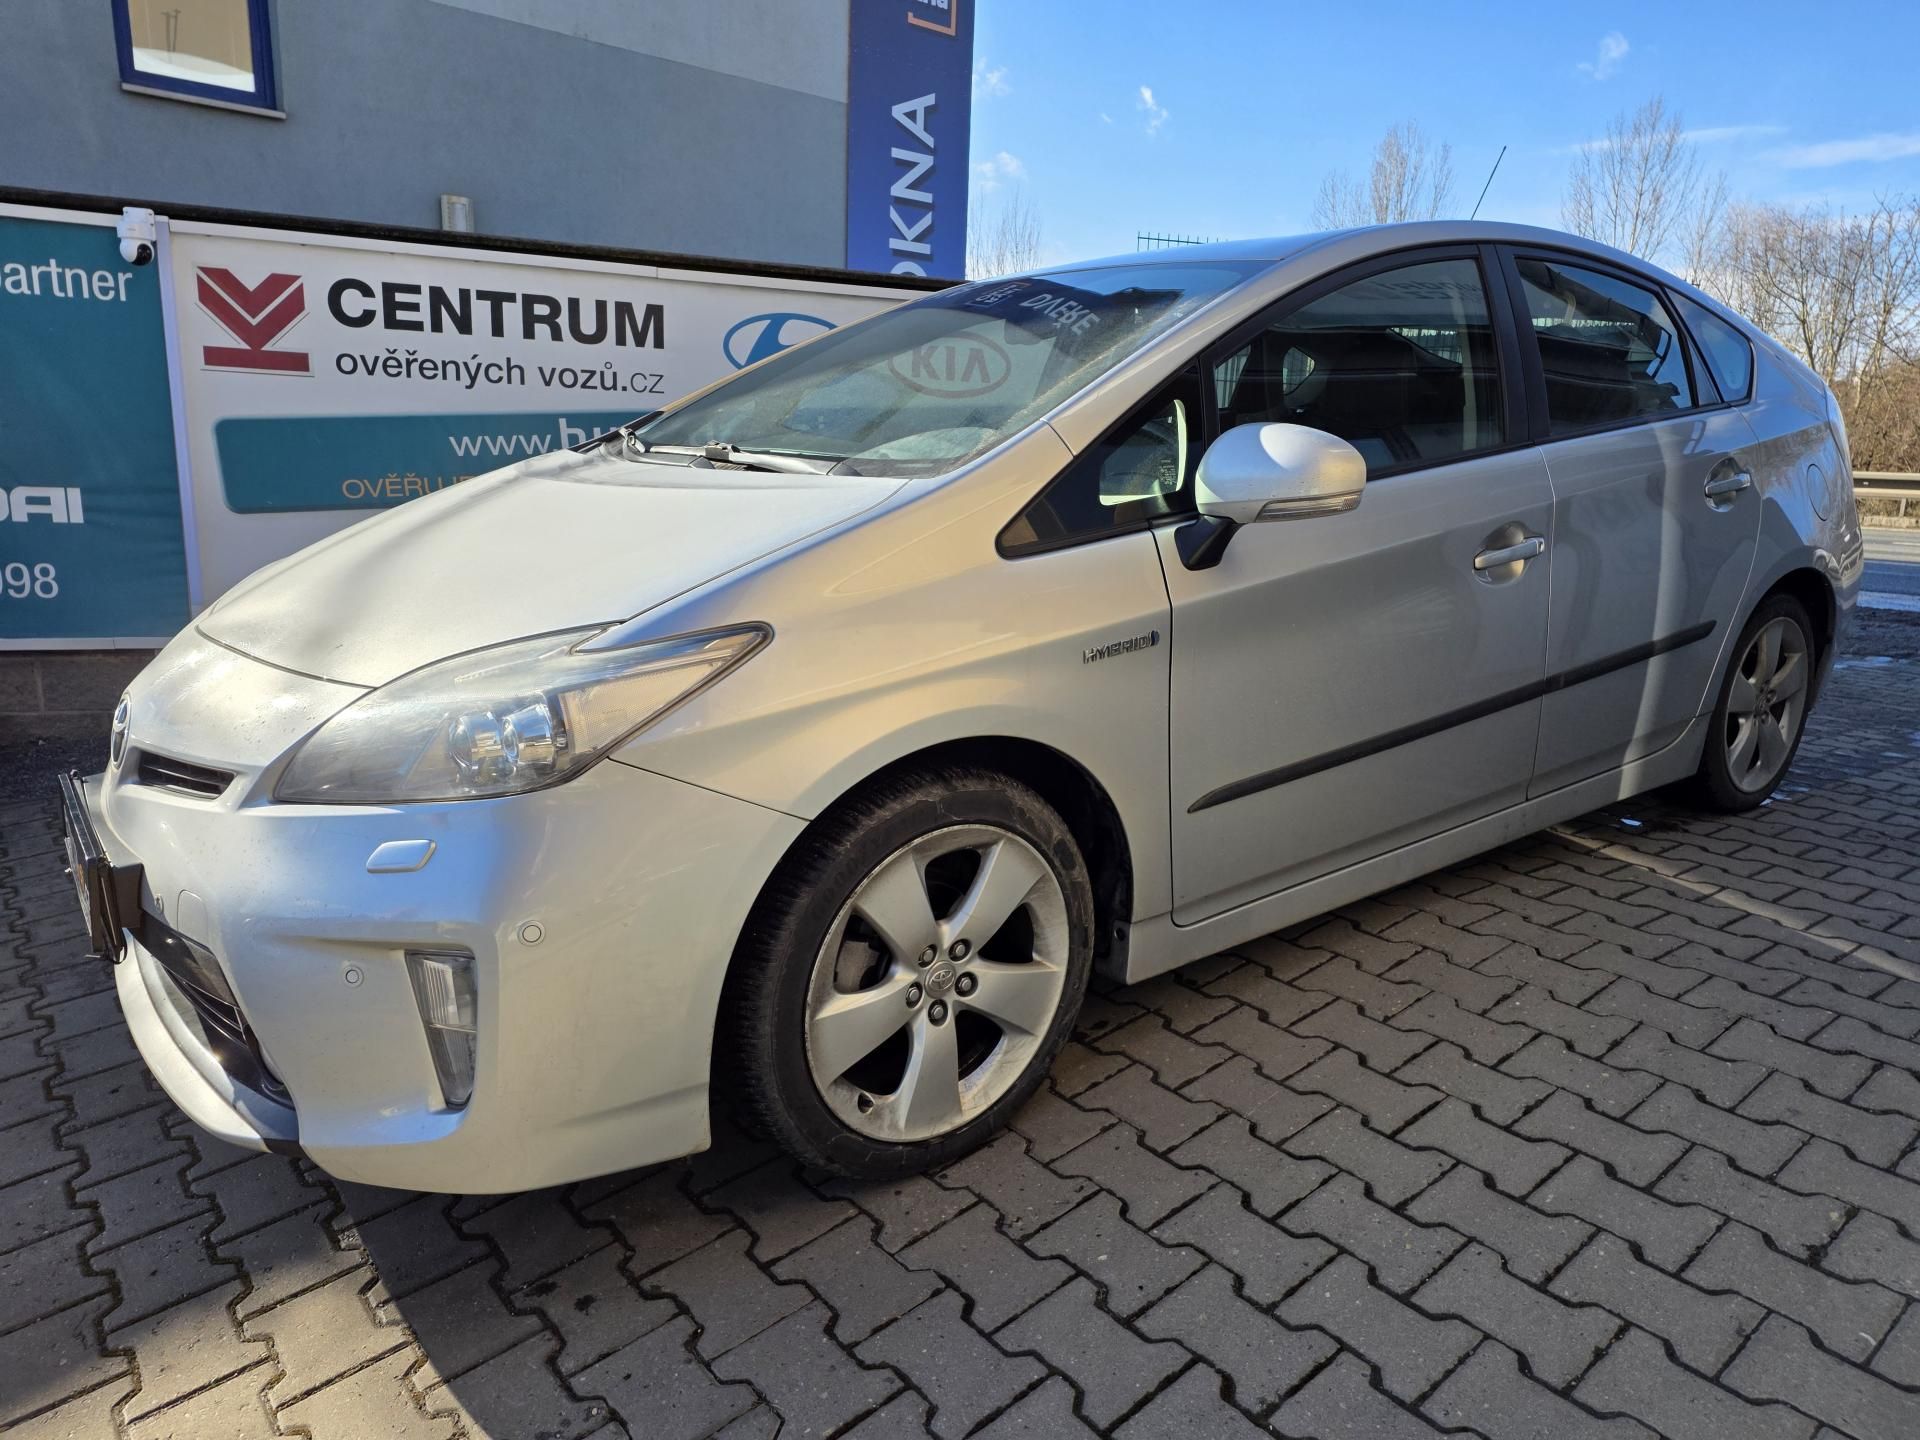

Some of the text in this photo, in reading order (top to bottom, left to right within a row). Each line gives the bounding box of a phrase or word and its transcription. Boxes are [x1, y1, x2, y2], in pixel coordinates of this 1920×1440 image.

[0, 258, 133, 302] artner
[327, 277, 666, 350] CENTRUM
[335, 348, 526, 390] ověřených
[910, 345, 993, 384] KIA
[0, 562, 59, 599] 98
[1082, 633, 1152, 664] HYBRID
